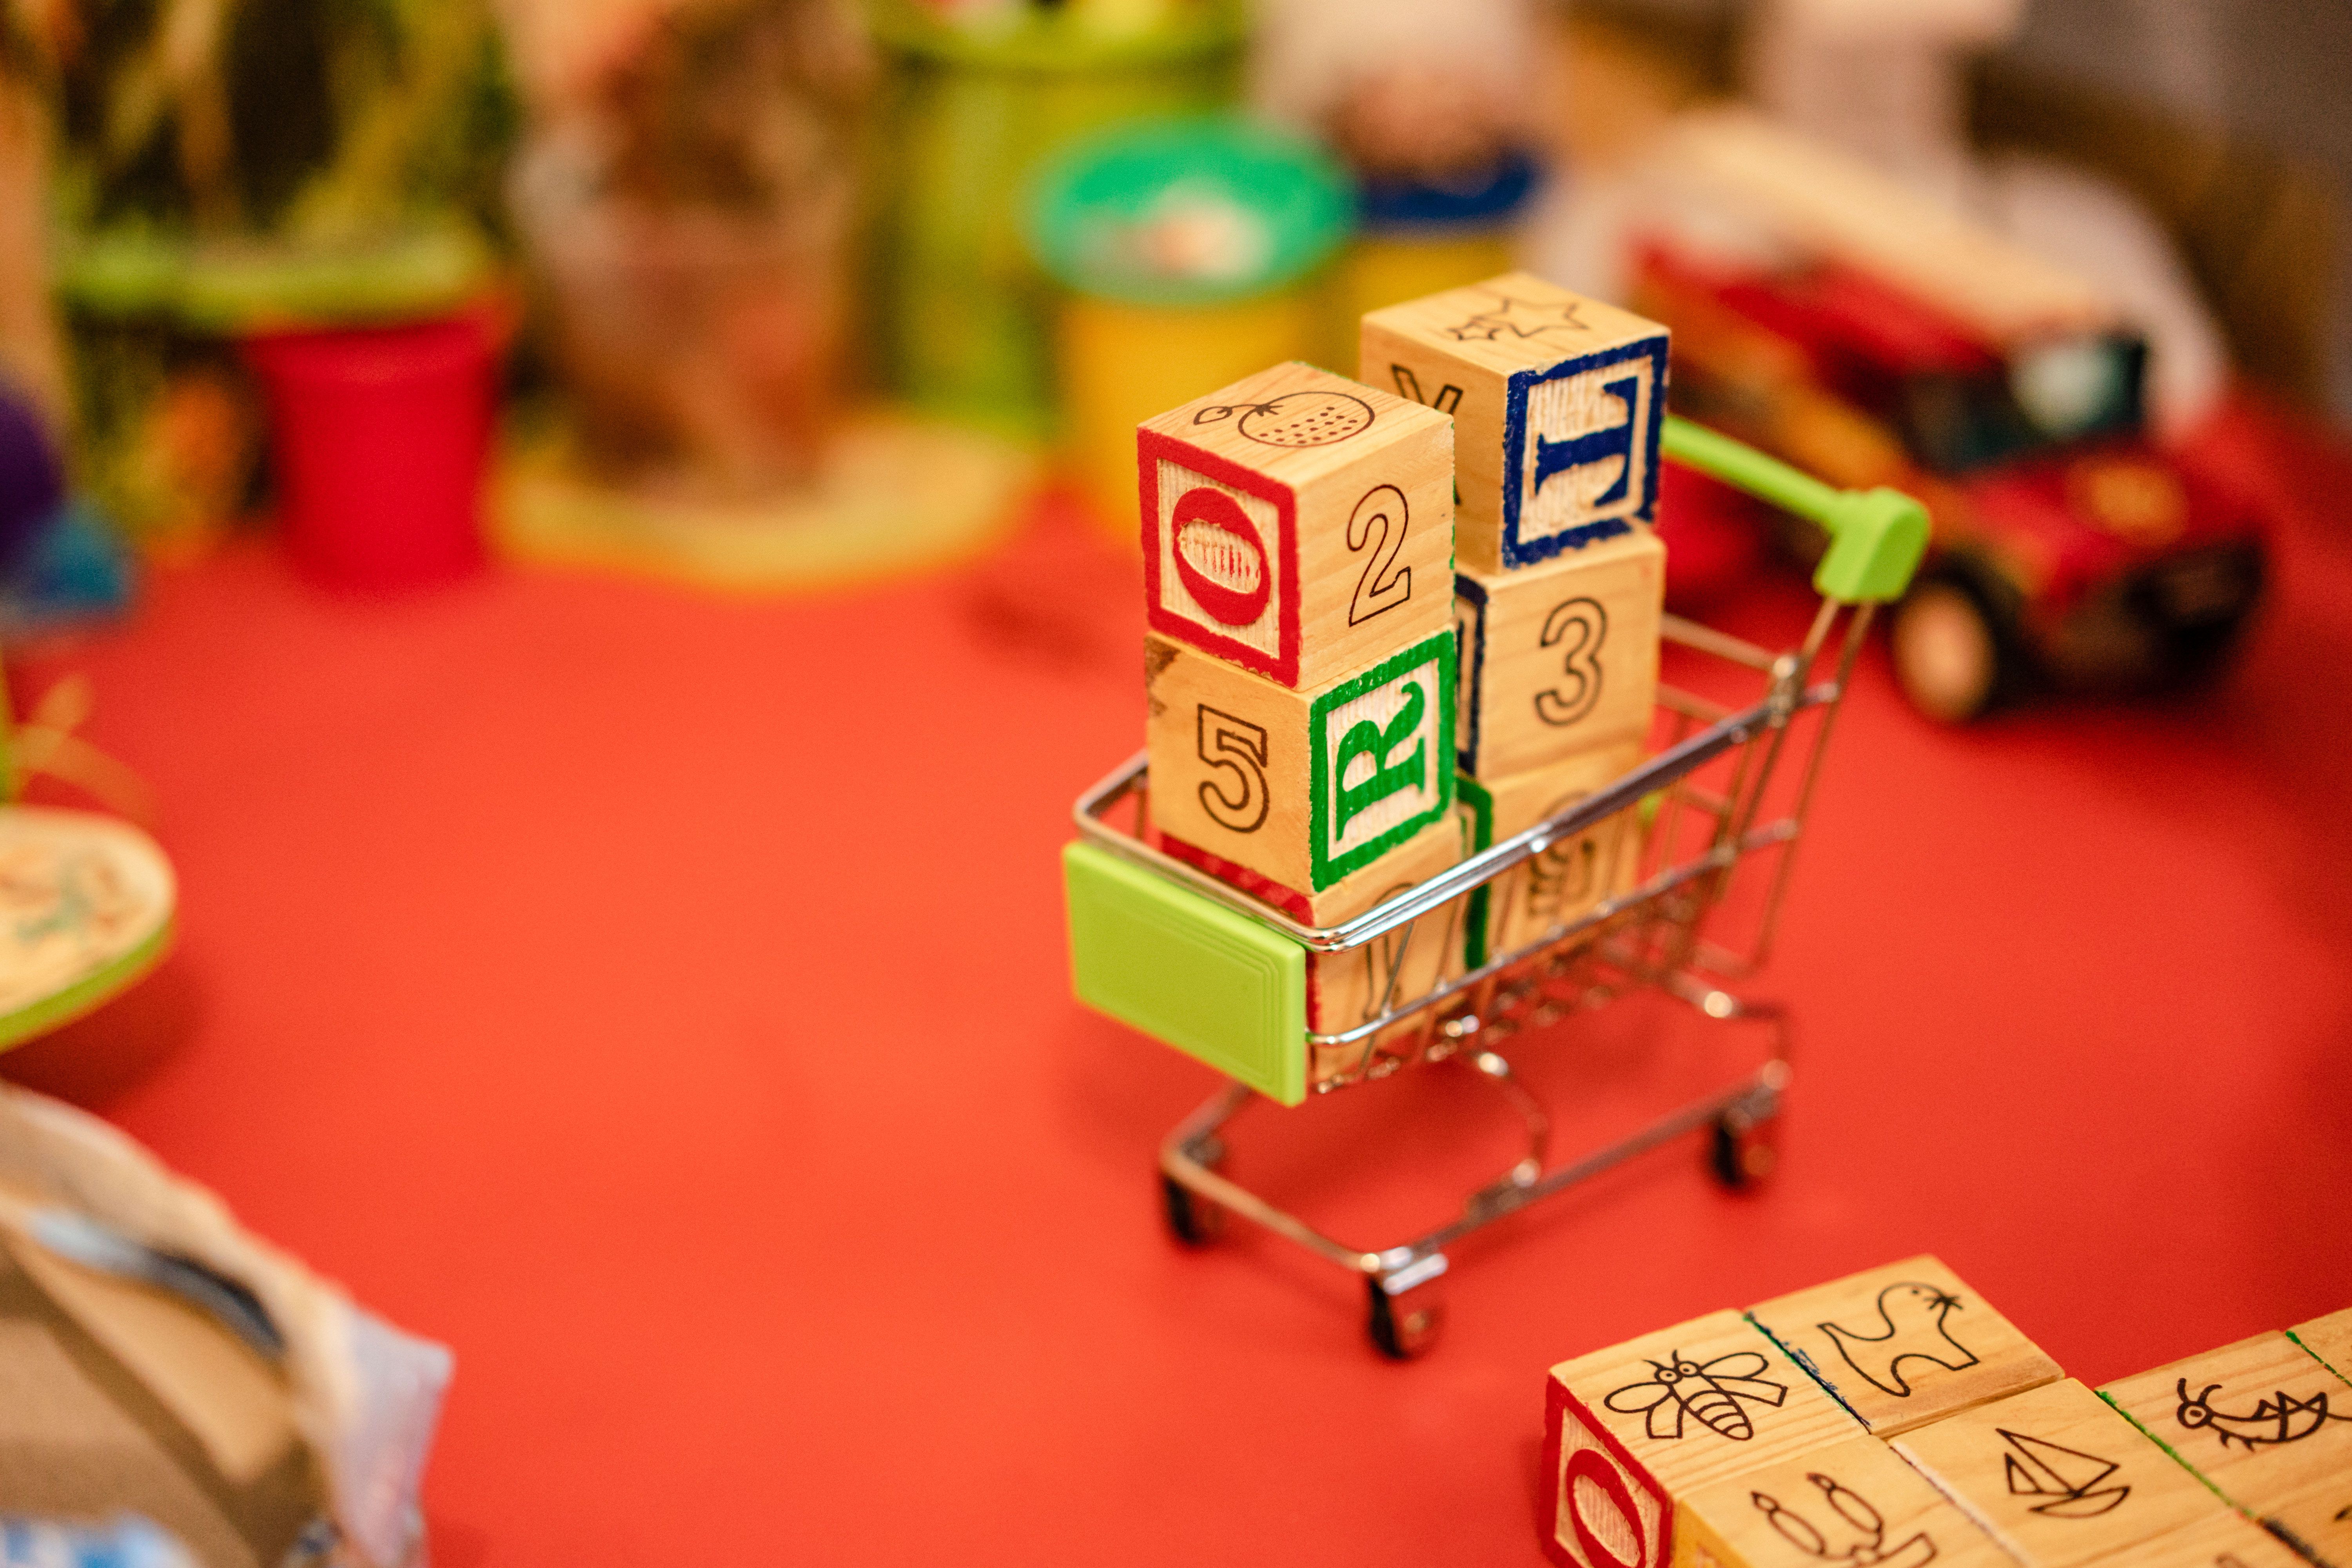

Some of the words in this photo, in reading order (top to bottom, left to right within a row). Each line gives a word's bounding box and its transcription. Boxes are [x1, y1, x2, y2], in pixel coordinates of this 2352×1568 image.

[1532, 376, 1639, 507] T
[1172, 487, 1271, 626] O
[1347, 484, 1411, 627] 2
[1535, 597, 1607, 726] 3
[1198, 704, 1270, 833] 5
[1335, 681, 1427, 842] R
